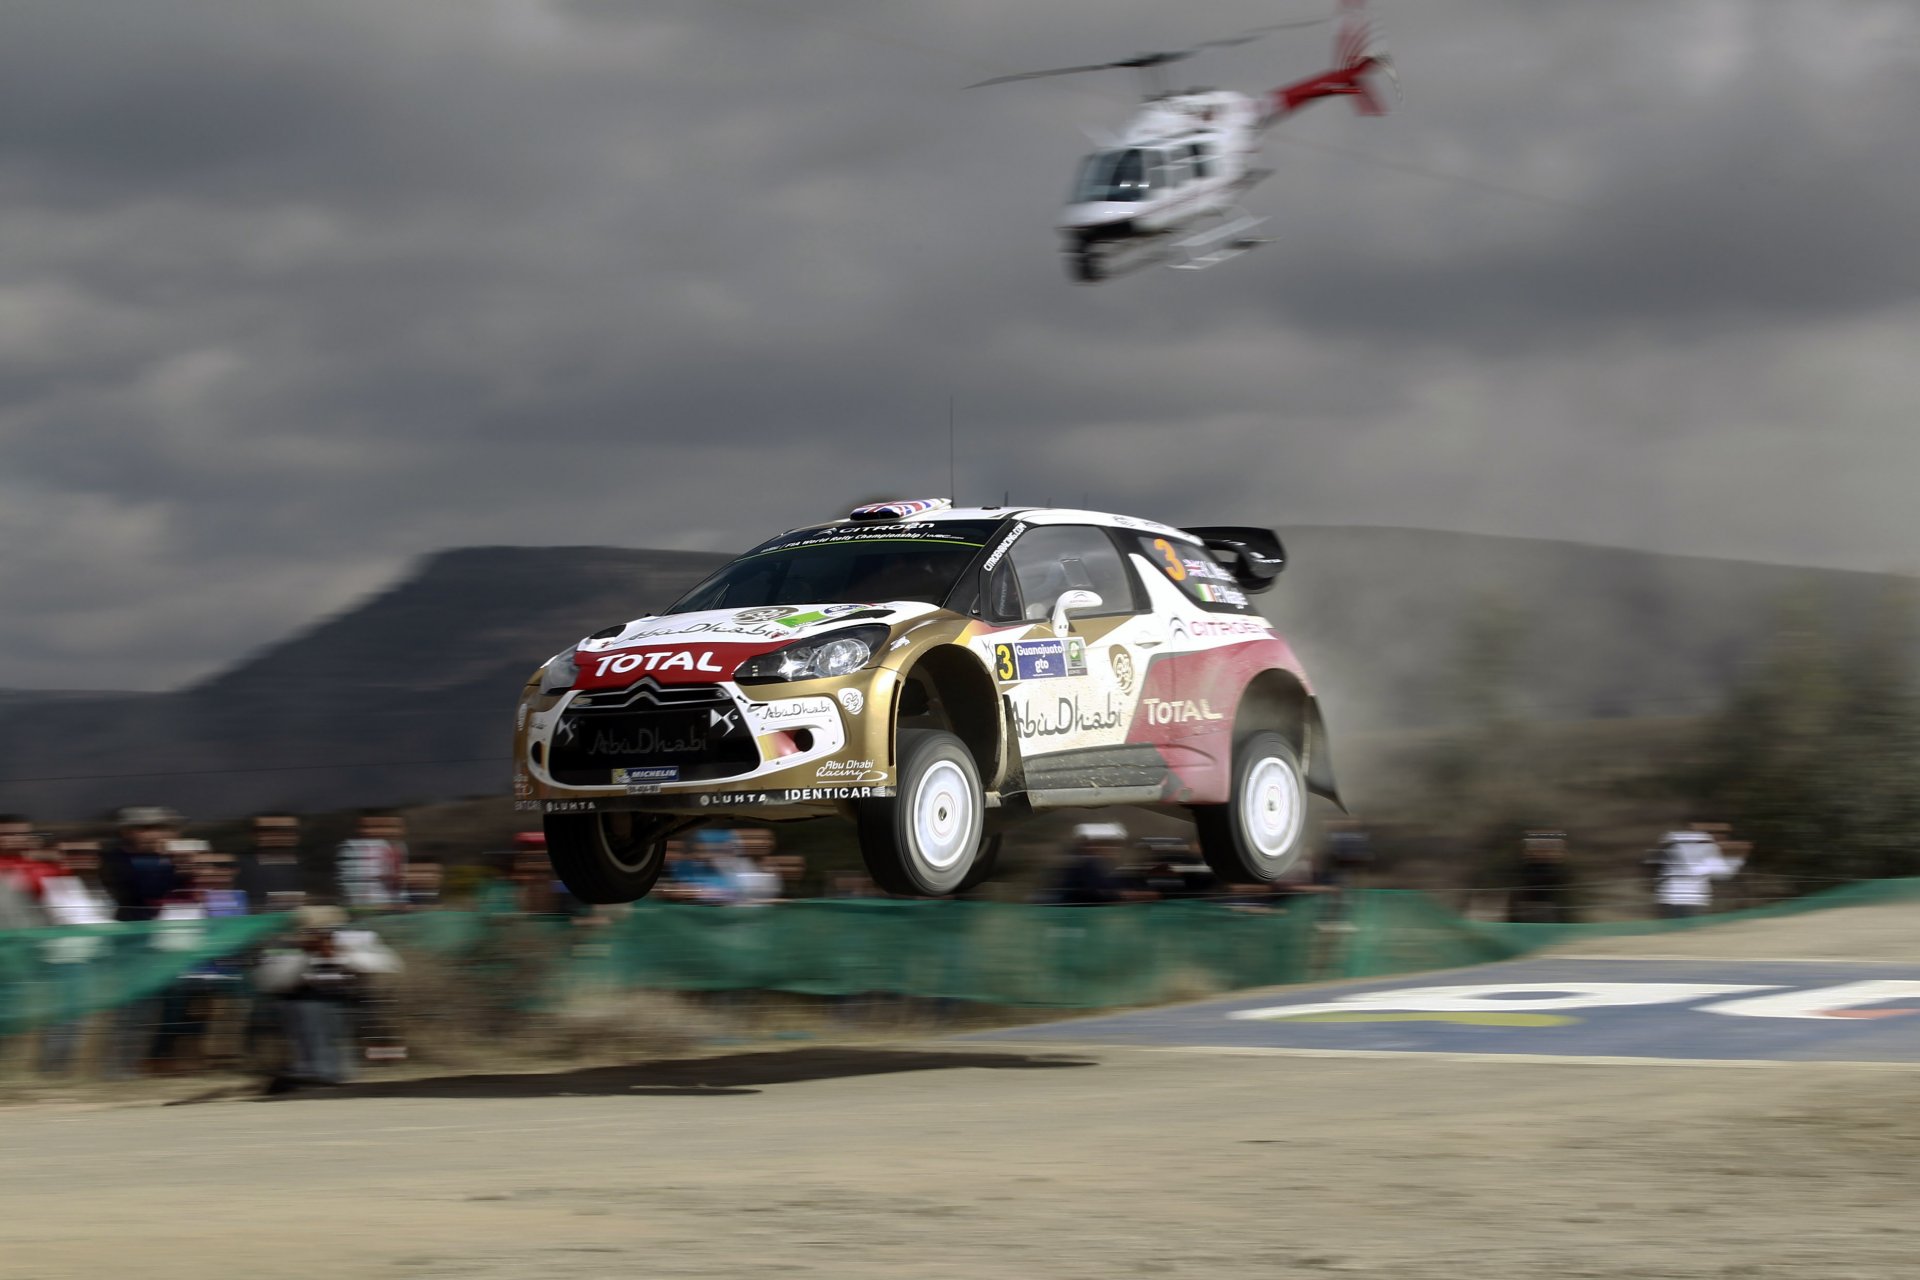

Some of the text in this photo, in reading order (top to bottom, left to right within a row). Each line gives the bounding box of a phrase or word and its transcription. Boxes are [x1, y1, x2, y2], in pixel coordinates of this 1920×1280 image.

[853, 532, 921, 540] Championship
[1153, 538, 1187, 581] 3
[1016, 643, 1063, 659] Guanajuato
[595, 651, 723, 677] TOTAL
[997, 644, 1014, 680] 3
[1034, 658, 1050, 673] gto
[1143, 698, 1224, 725] TOTAL
[825, 759, 874, 769] Abu Dhabi
[631, 769, 677, 778] MICHELIN
[712, 793, 769, 804] LUHTA
[785, 786, 871, 801] IDENTICAR
[554, 801, 596, 811] LUHTA
